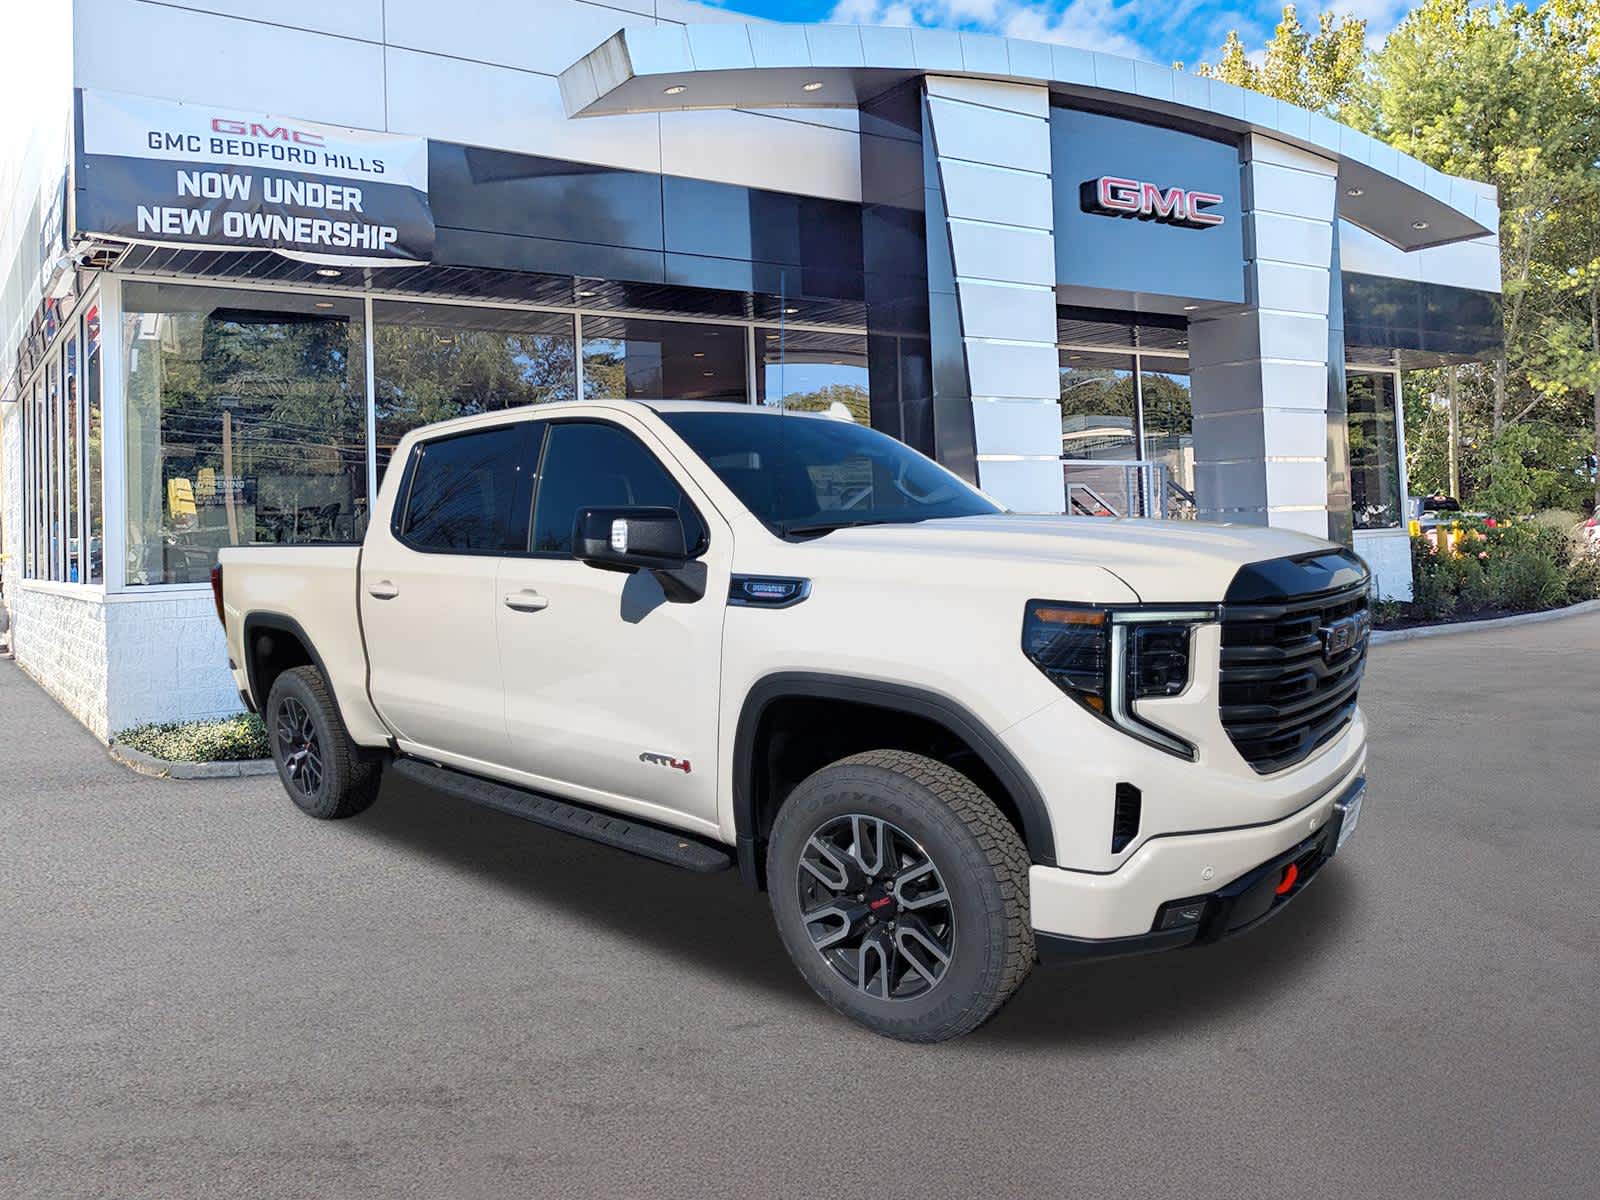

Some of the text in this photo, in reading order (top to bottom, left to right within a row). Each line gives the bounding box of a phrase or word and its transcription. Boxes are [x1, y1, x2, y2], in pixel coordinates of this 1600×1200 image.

[148, 131, 385, 174] GMC BEDFORD HILLS
[211, 118, 326, 148] GMC
[177, 170, 364, 213] NOW UNDER
[1098, 175, 1225, 225] GMC
[137, 206, 398, 250] NEW OWNERSHIP
